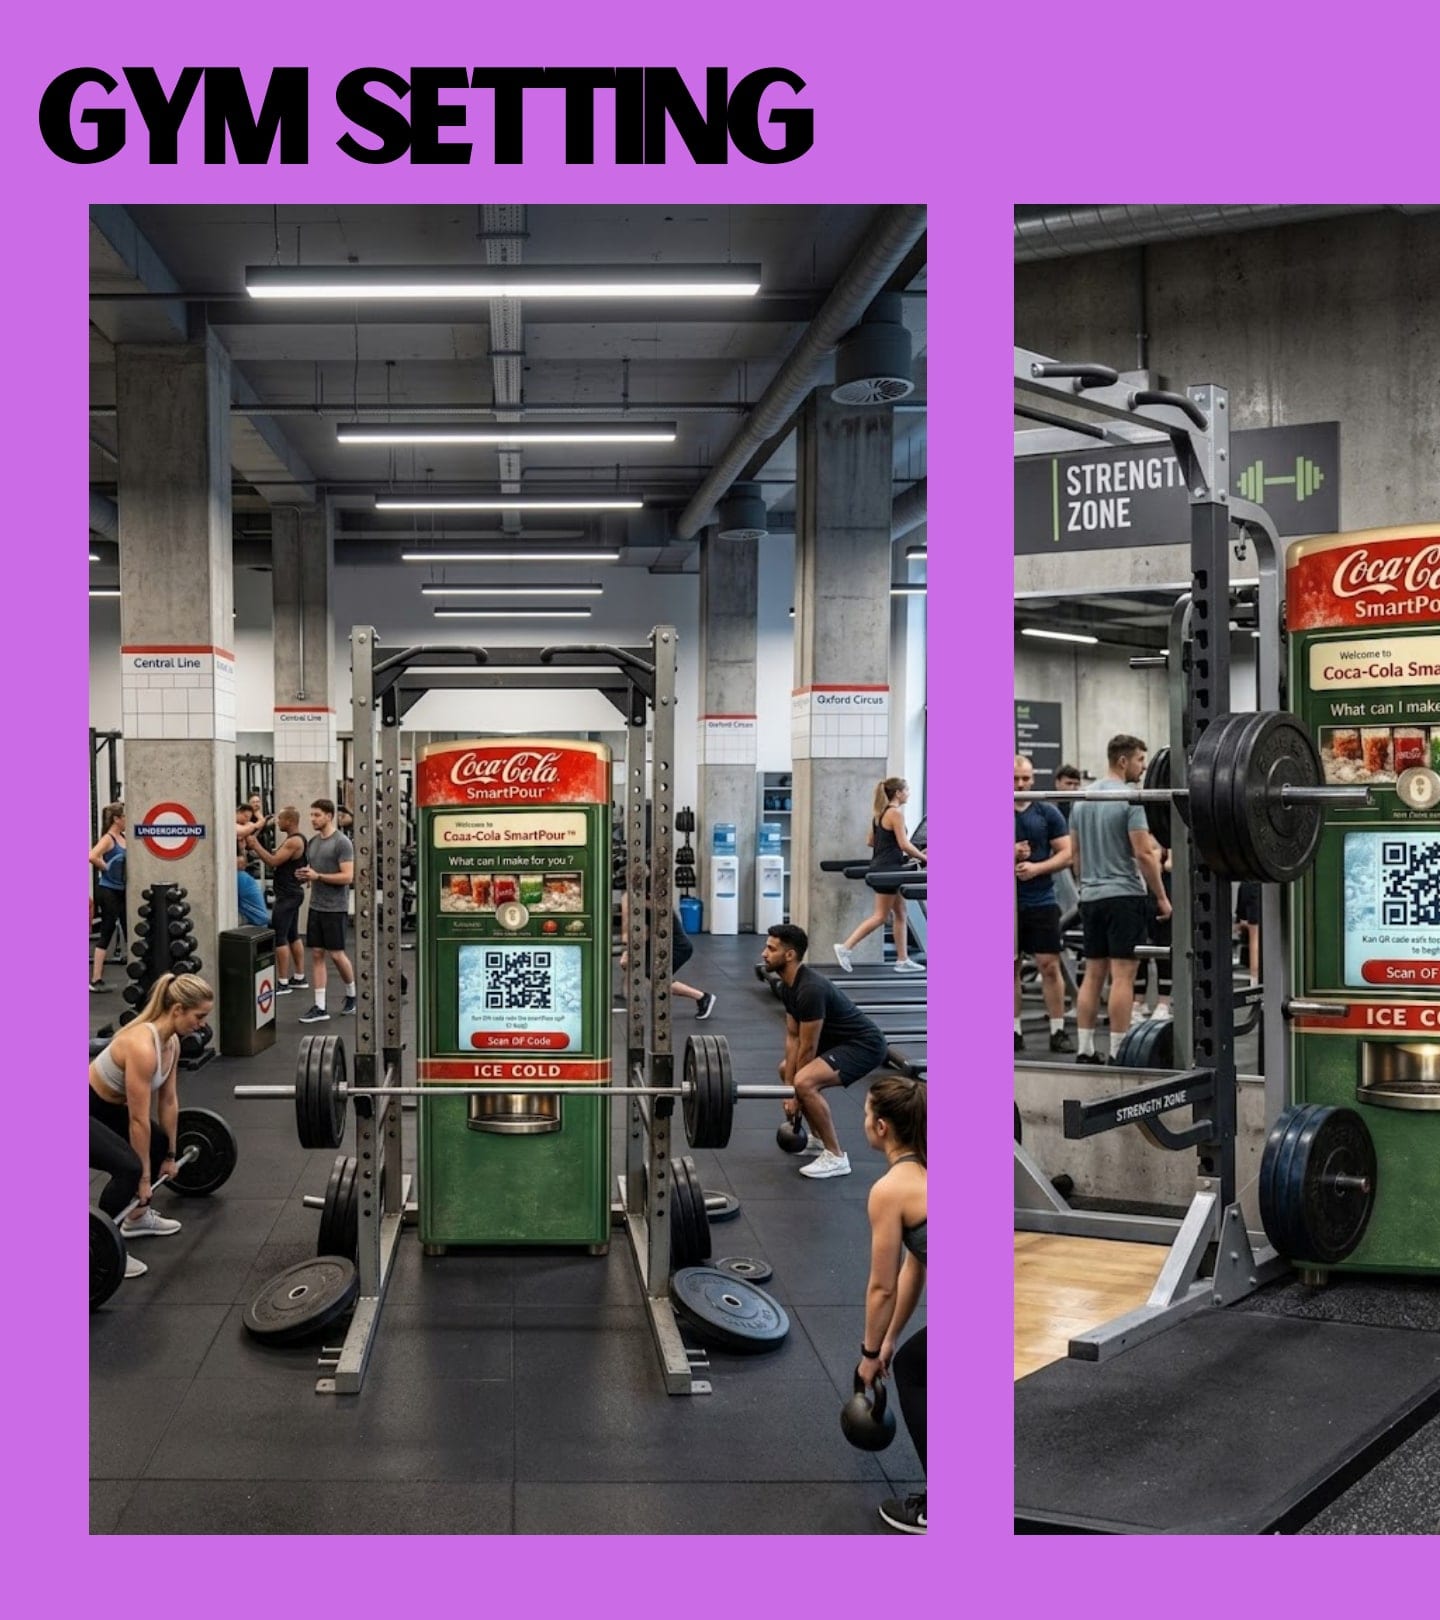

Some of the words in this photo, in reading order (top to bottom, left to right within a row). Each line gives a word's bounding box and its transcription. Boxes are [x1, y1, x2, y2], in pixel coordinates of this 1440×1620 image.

[1067, 497, 1131, 531] ZONE
[1339, 651, 1379, 660] Welcome
[1382, 650, 1392, 659] to
[134, 657, 174, 668] Central
[177, 657, 201, 668] Line
[1323, 664, 1403, 681] Coca-Cola
[817, 694, 850, 705] Oxford
[853, 694, 884, 705] Circus
[1330, 702, 1367, 717] What
[1370, 703, 1394, 715] can
[449, 856, 475, 866] What
[477, 859, 494, 867] can
[503, 856, 529, 866] make
[531, 856, 545, 865] for
[1386, 967, 1416, 979] Scan
[1420, 967, 1439, 979] OF
[1366, 1008, 1407, 1026] ICE
[487, 1036, 509, 1046] Scan
[527, 1036, 551, 1046] Code
[474, 1065, 502, 1077] ICE
[512, 1065, 561, 1077] COLD
[1116, 1097, 1162, 1121] STRENGTH
